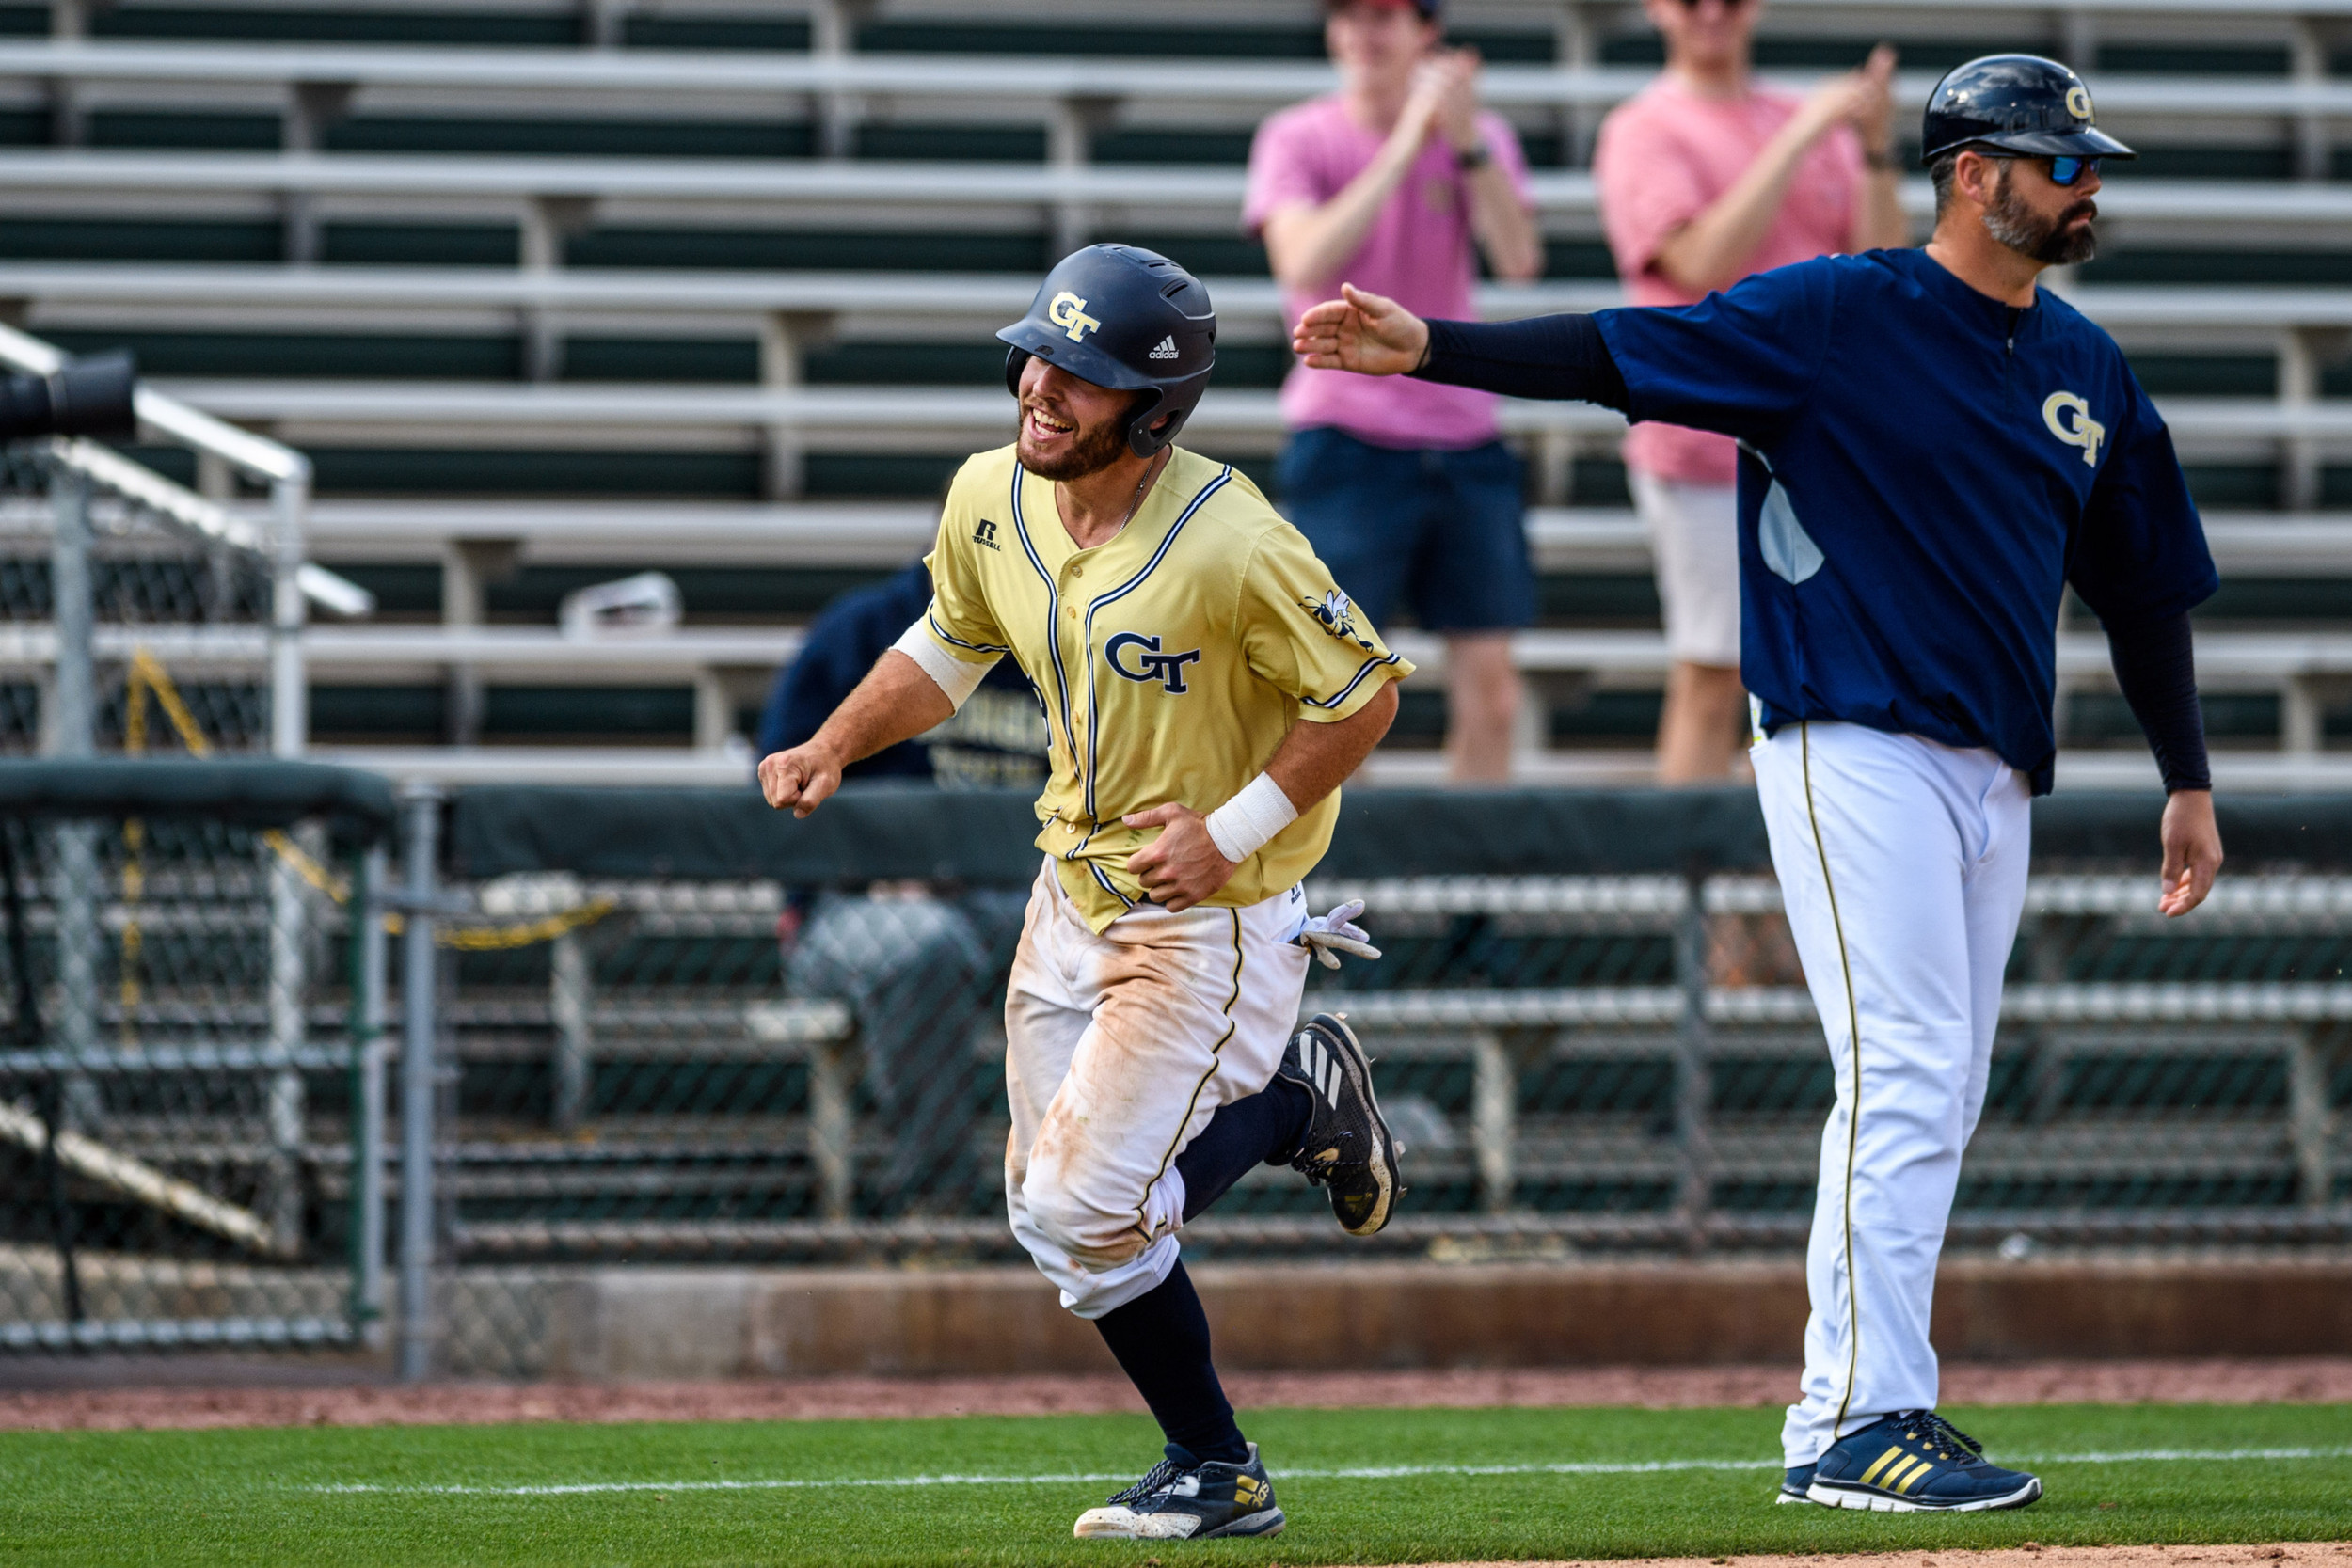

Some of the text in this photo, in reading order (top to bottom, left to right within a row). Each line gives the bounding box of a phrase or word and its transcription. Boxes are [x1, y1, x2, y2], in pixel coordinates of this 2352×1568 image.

[1048, 291, 1102, 343] GT
[1149, 349, 1179, 359] adidas
[2042, 390, 2106, 469] GT
[975, 518, 997, 541] R
[1104, 630, 1201, 695] GT
